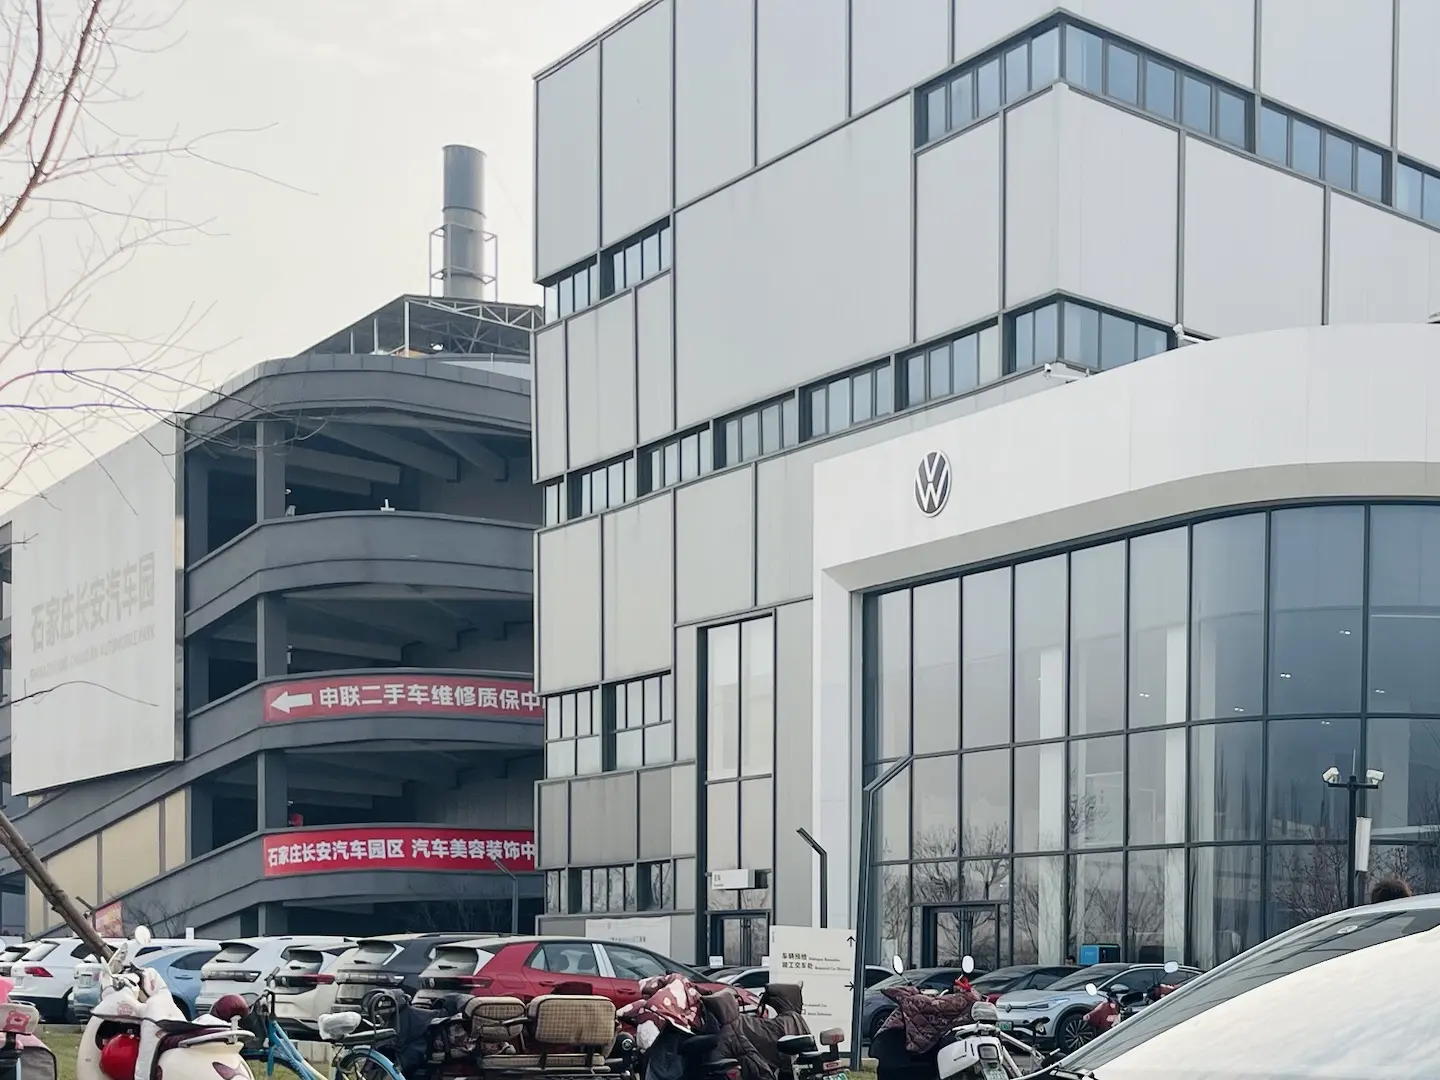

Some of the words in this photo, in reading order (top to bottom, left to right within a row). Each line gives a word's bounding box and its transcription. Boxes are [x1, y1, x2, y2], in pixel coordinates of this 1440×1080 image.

[31, 551, 155, 653] 石家庄长安汽车园
[319, 683, 546, 711] 申联二手车维修质保中
[267, 839, 405, 867] 石家庄长安汽车园区
